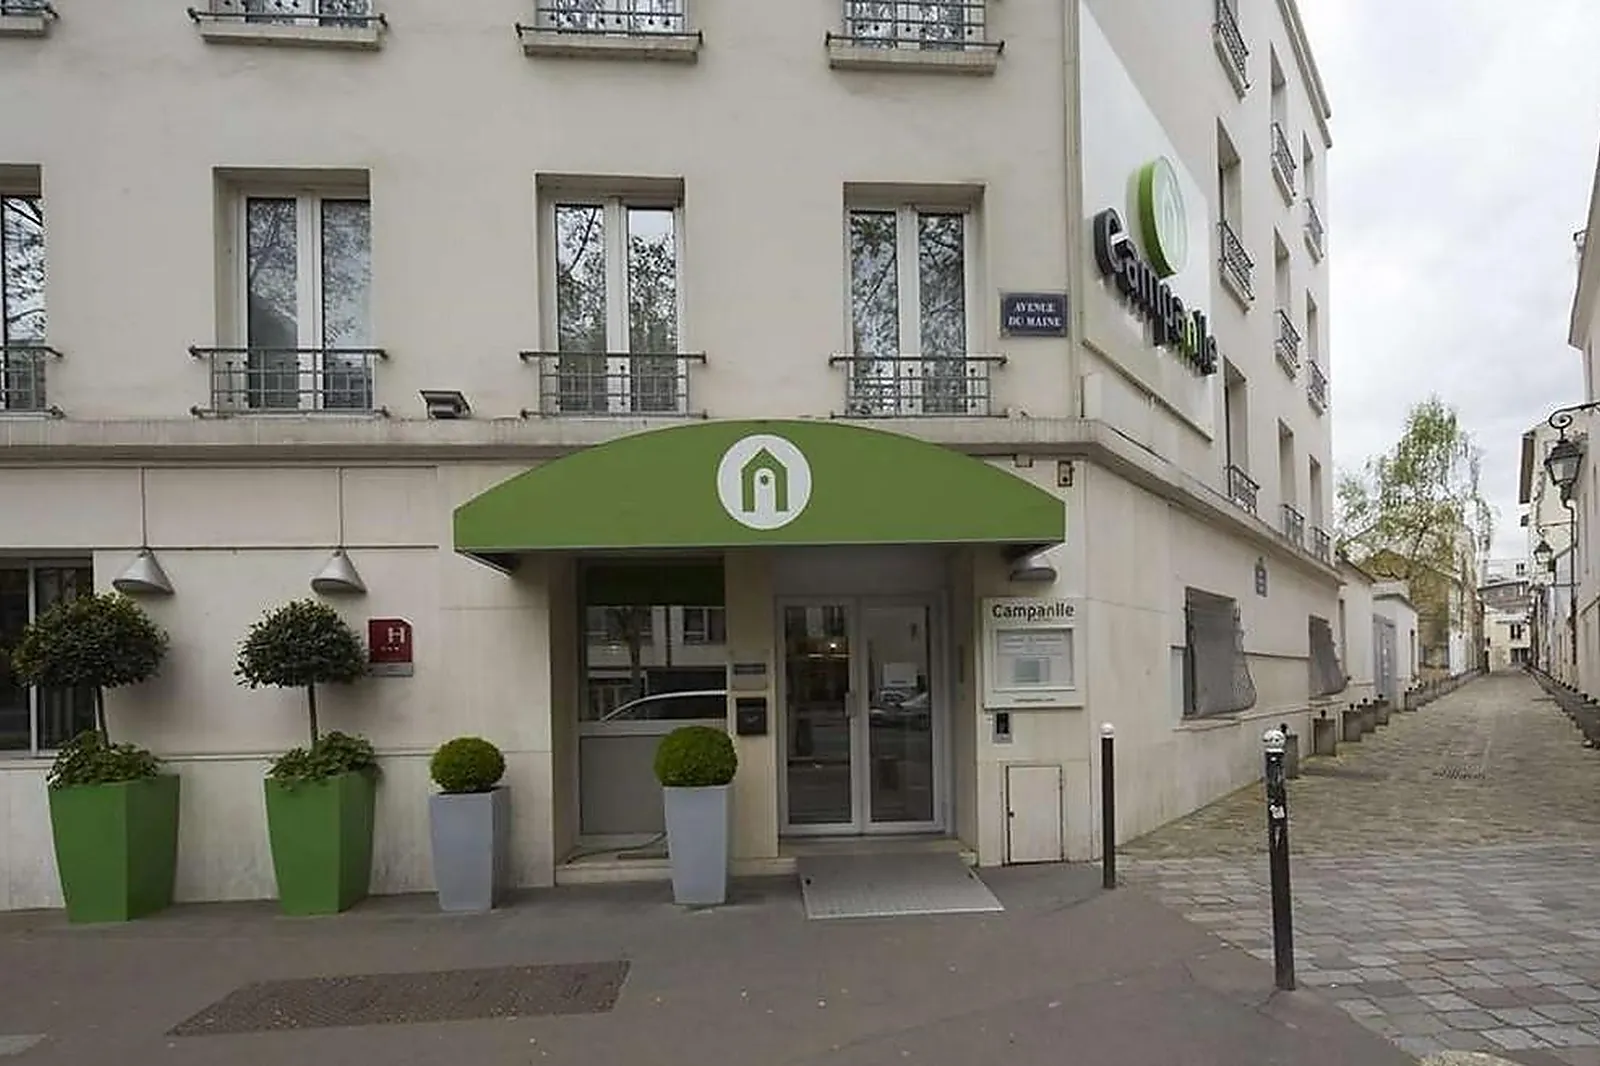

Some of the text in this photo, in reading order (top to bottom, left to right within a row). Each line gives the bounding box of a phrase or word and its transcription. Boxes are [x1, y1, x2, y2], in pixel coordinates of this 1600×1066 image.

[1014, 302, 1056, 312] AVENUE
[1008, 316, 1062, 327] DU MAINE
[991, 602, 1075, 621] Campanile
[387, 626, 406, 643] H
